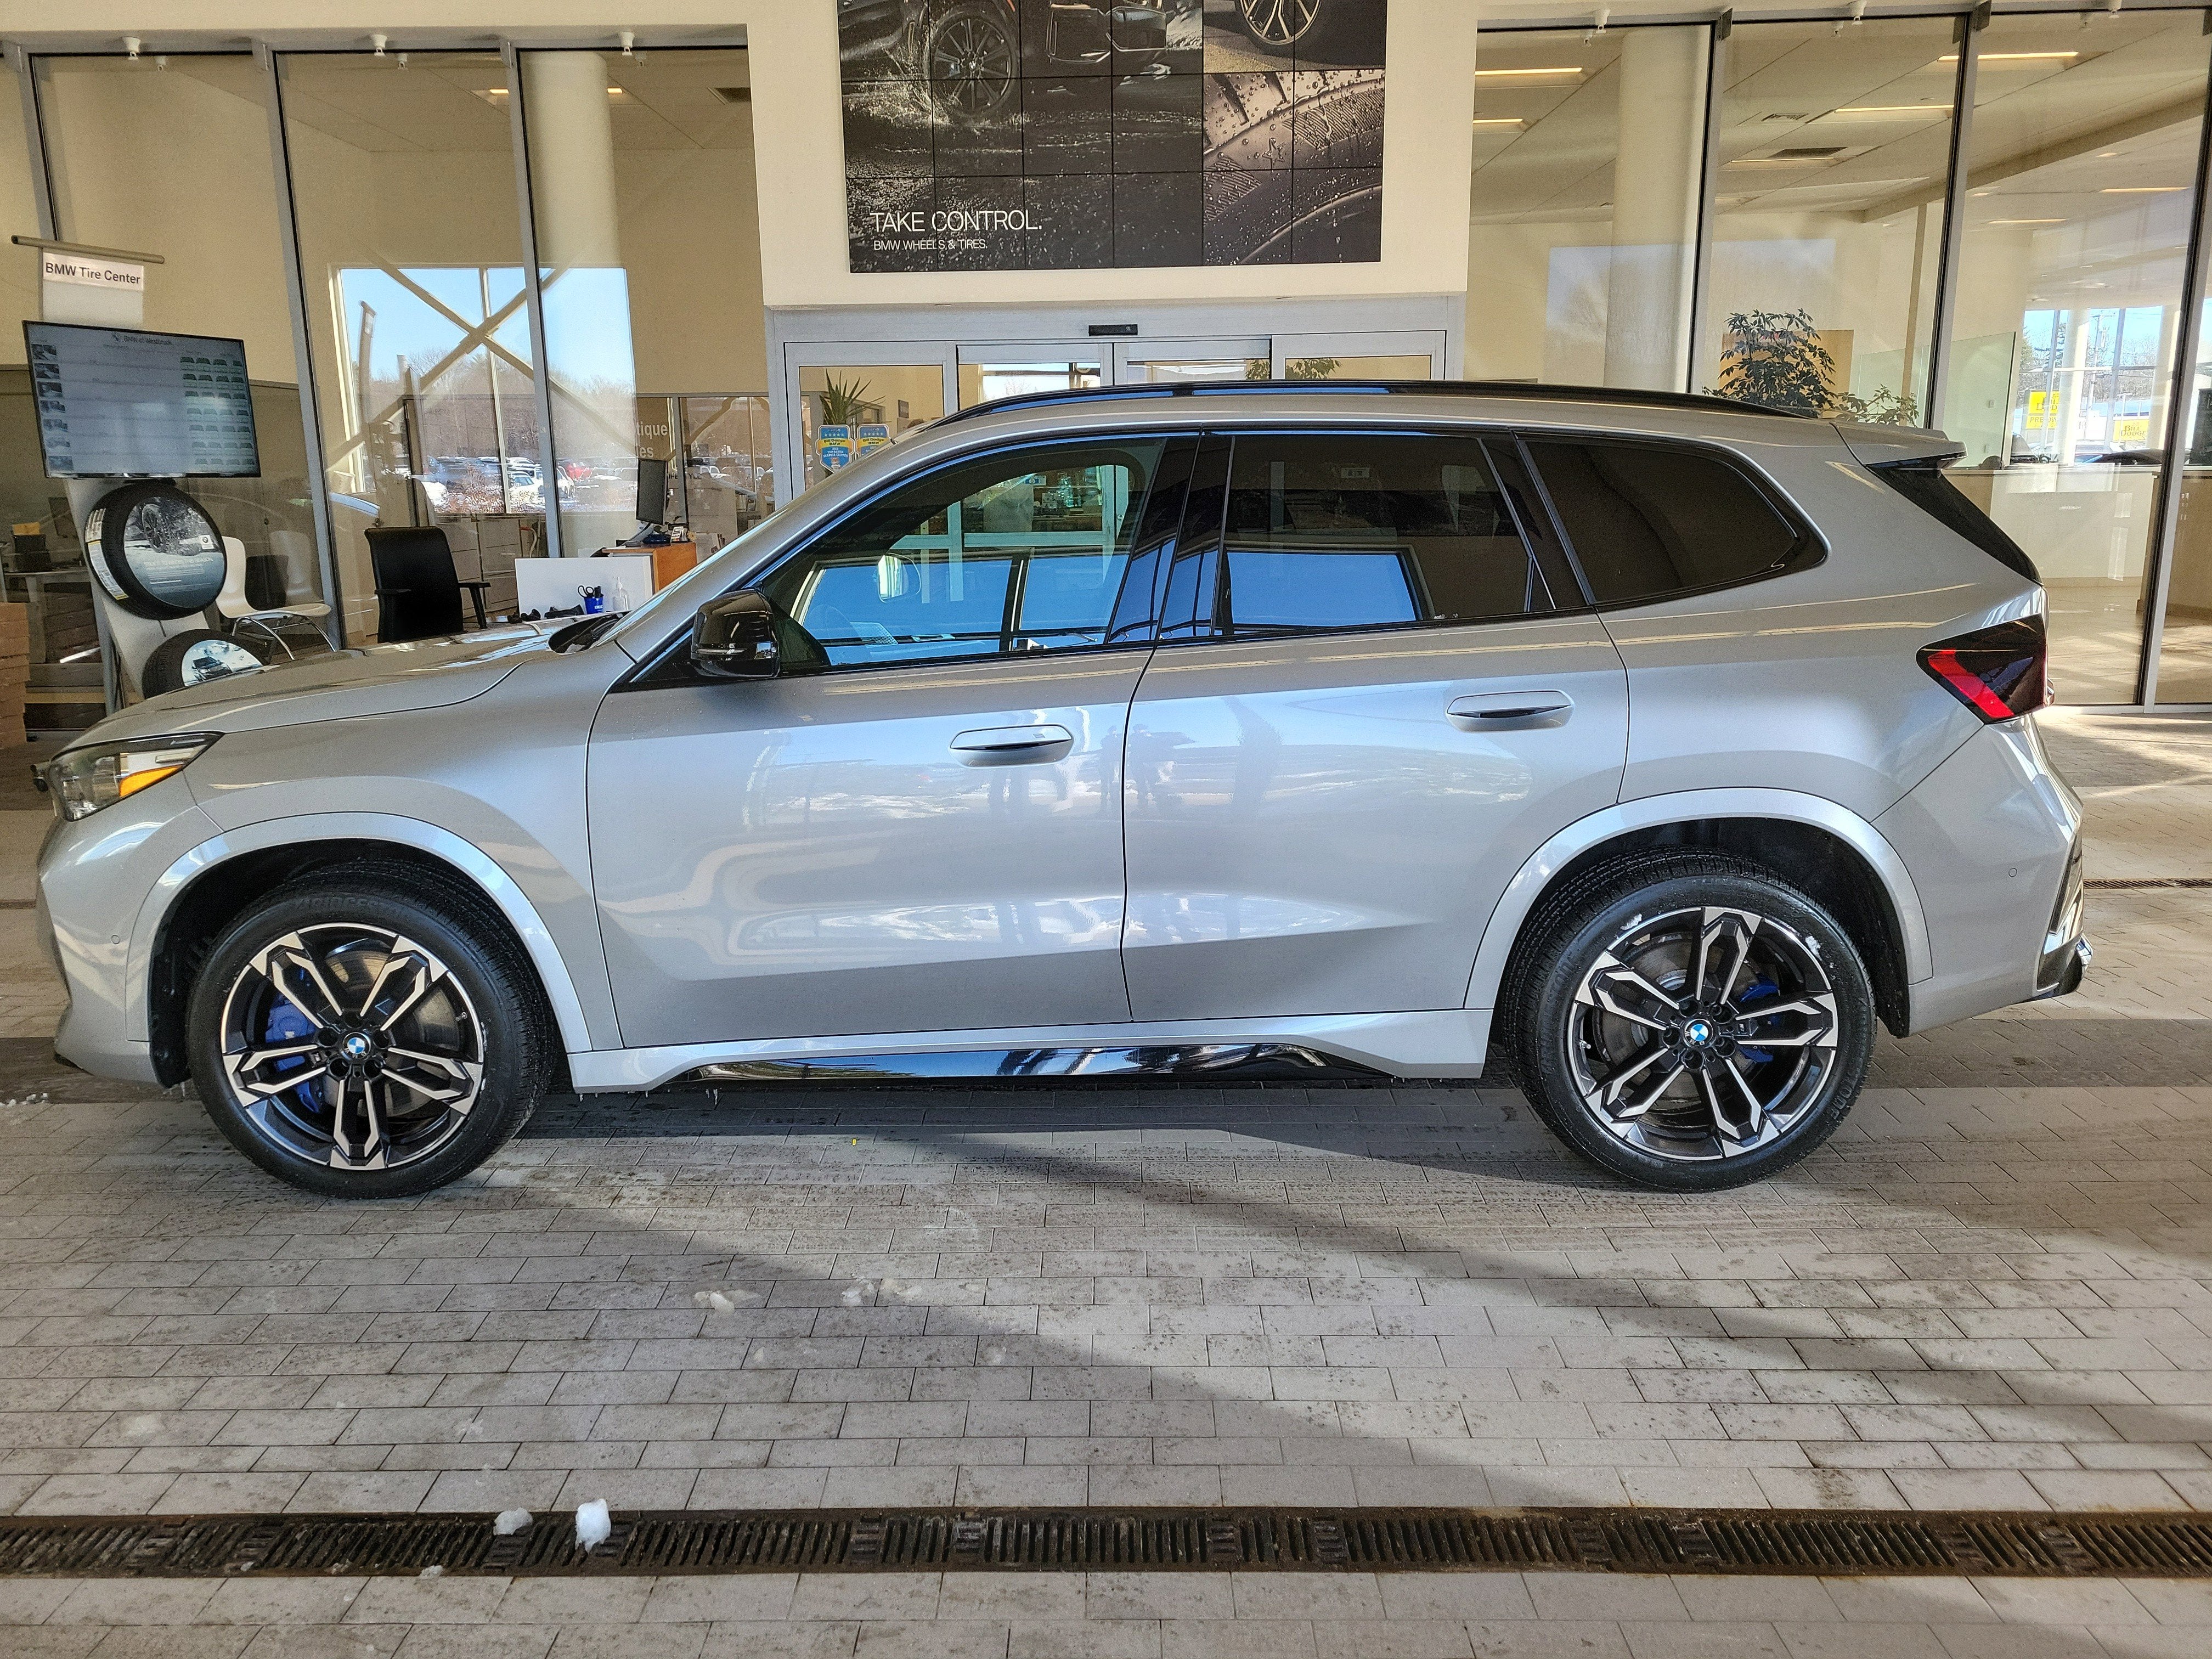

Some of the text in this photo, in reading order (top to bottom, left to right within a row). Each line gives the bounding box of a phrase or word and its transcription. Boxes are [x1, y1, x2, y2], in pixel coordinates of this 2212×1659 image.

[870, 210, 1042, 232] TAKE CONTROL.
[874, 239, 988, 250] BMW WHEELS & TIRES.
[46, 262, 140, 284] BMW Tire Center
[637, 421, 668, 439] tique
